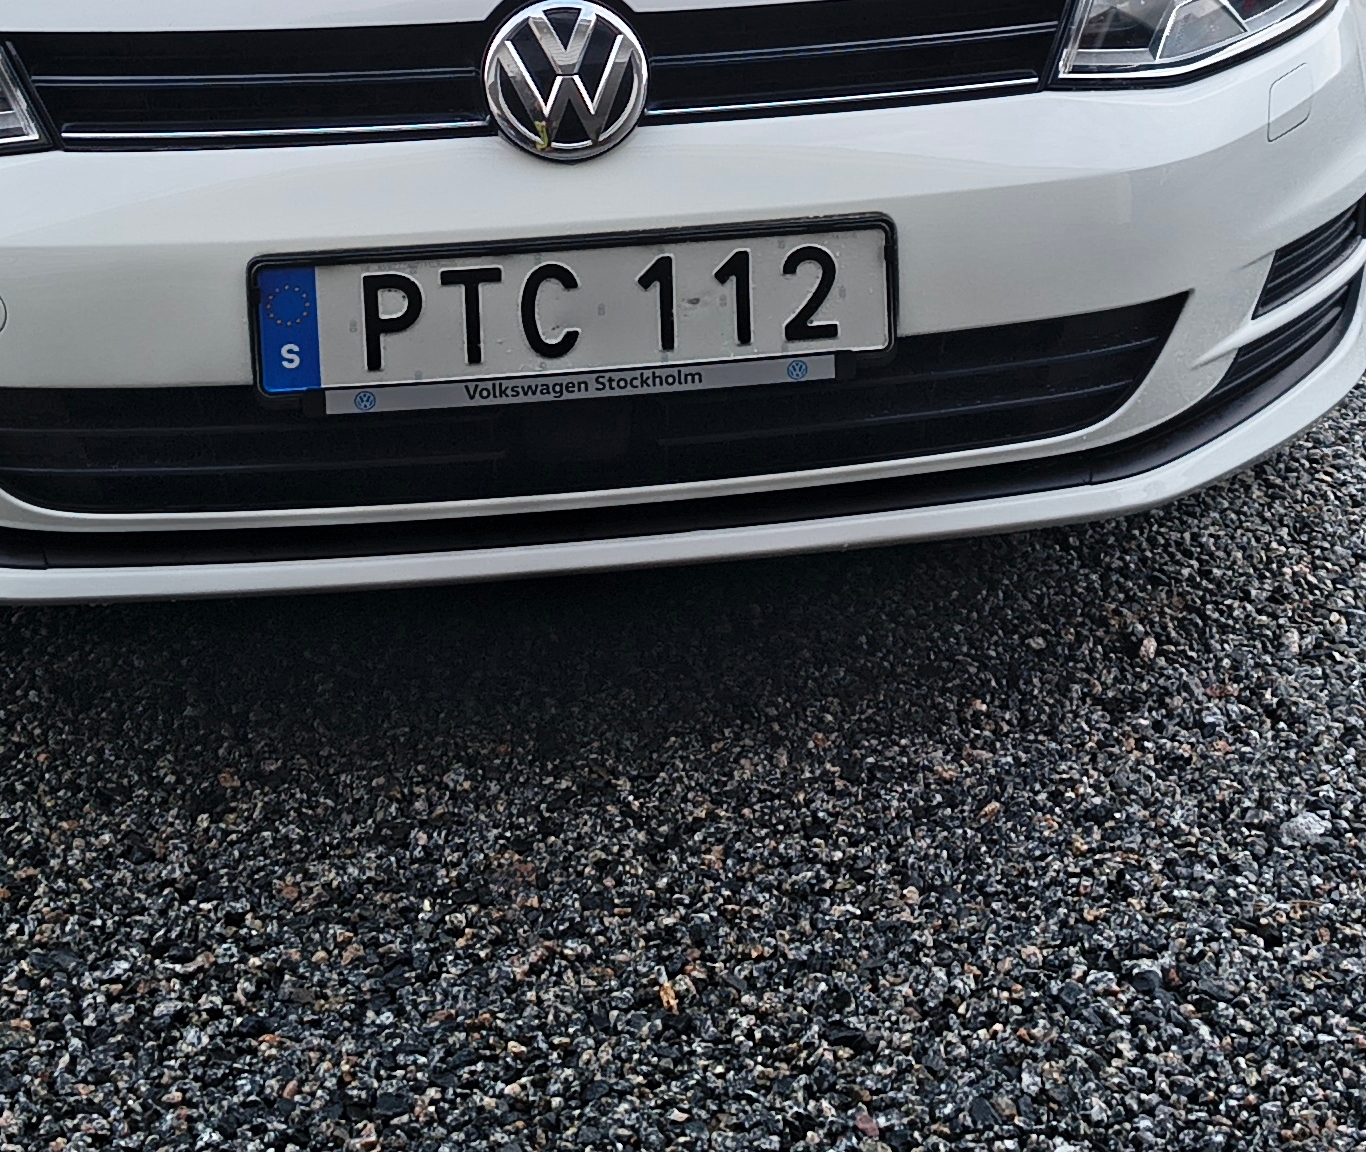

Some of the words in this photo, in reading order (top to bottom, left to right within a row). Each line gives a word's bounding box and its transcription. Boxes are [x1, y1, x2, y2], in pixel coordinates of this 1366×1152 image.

[487, 0, 647, 158] VW
[362, 262, 580, 371] PTC
[637, 245, 839, 351] 112
[280, 343, 301, 369] S
[464, 379, 589, 400] Volkswagen
[594, 369, 703, 391] Stockholm
